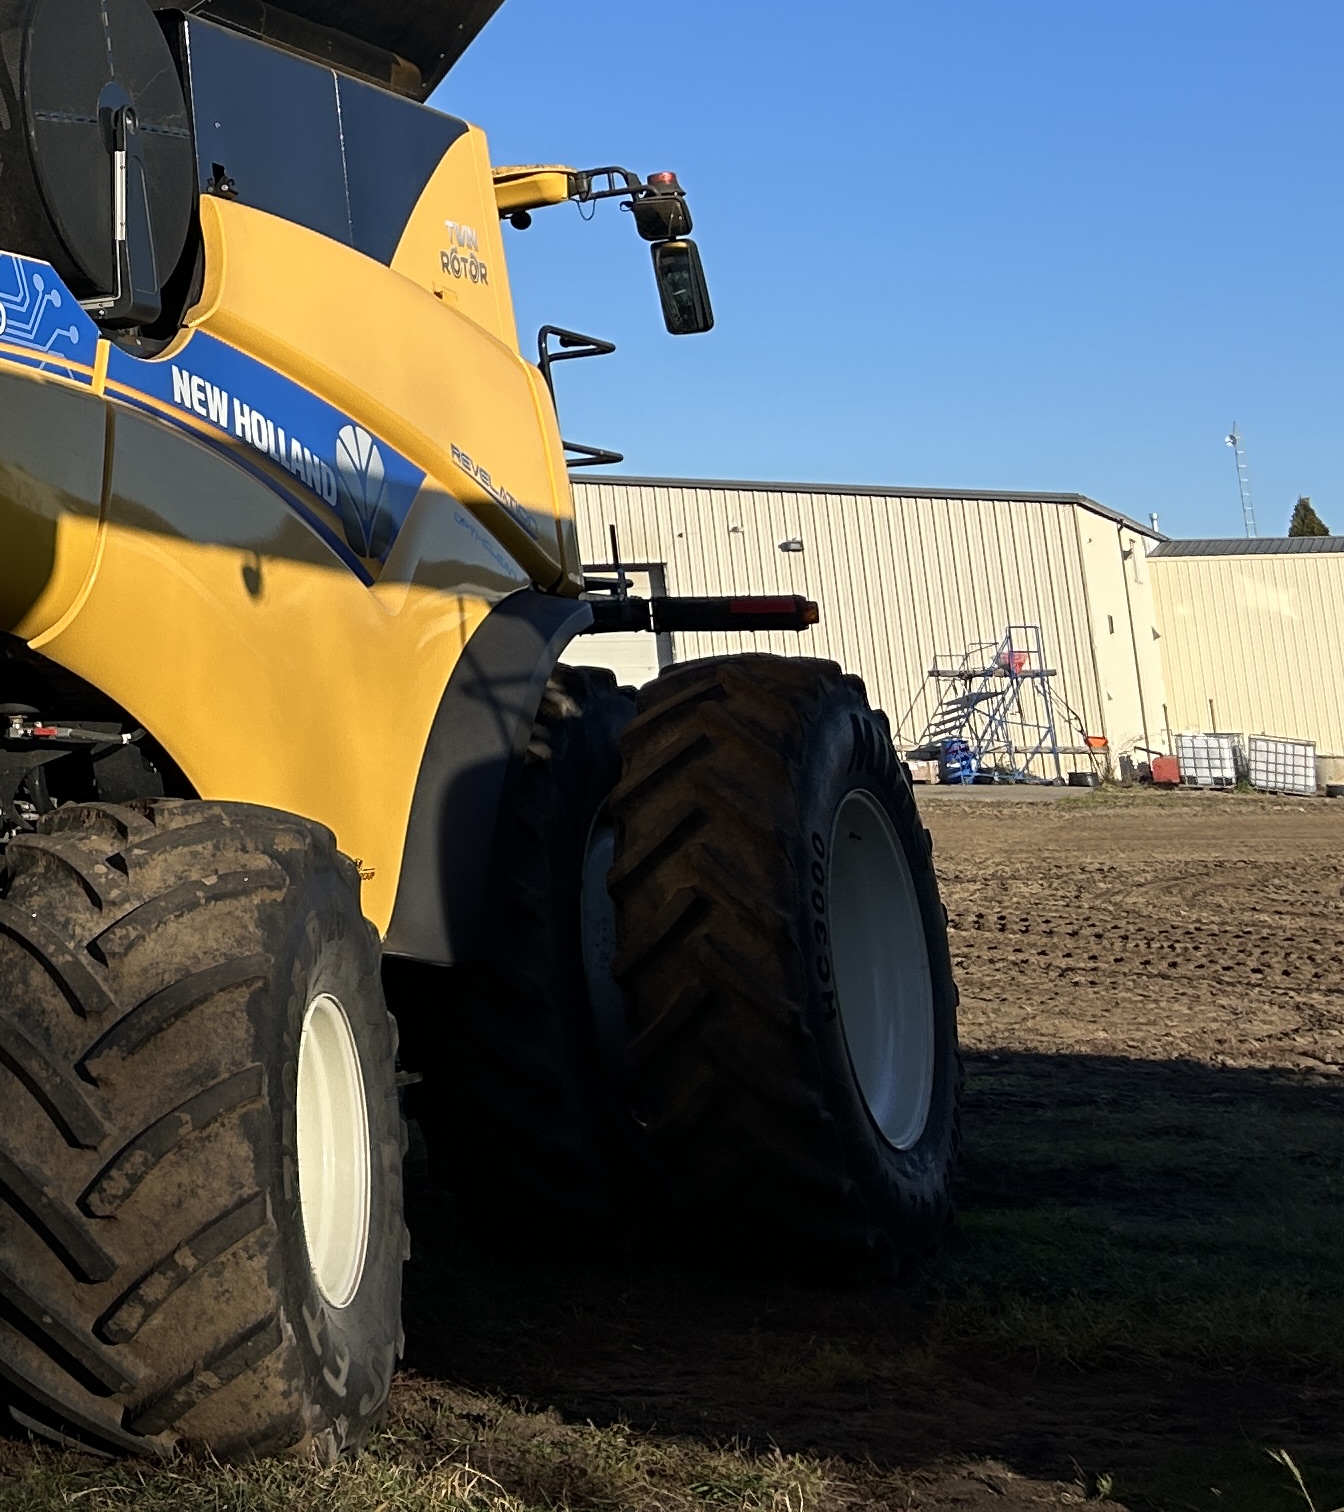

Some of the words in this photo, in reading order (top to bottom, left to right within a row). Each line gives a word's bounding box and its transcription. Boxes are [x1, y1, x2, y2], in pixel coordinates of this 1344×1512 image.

[440, 246, 489, 286] ROTOR
[171, 364, 228, 429] NEW
[233, 397, 338, 507] HOLLAND
